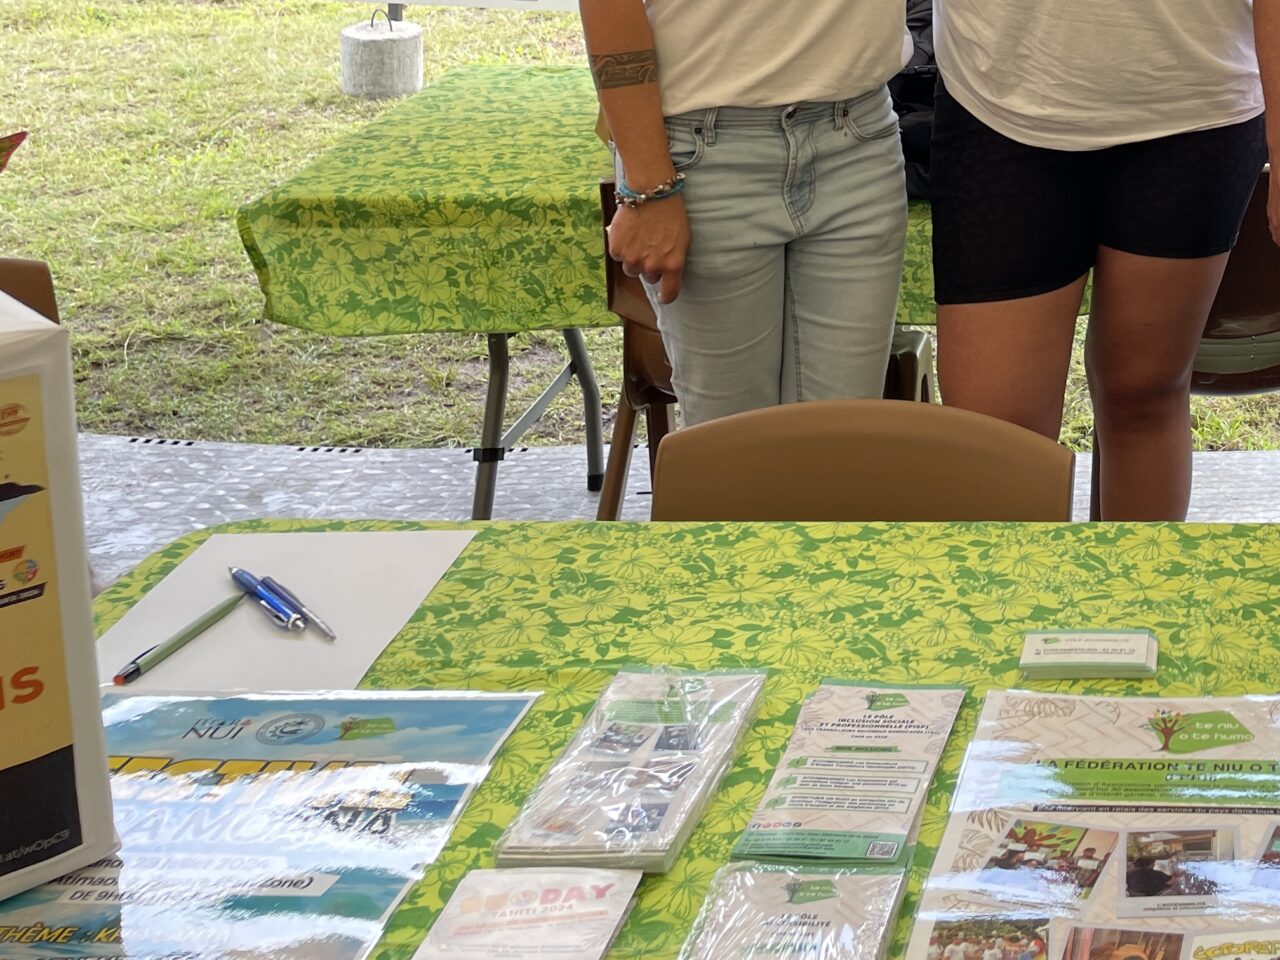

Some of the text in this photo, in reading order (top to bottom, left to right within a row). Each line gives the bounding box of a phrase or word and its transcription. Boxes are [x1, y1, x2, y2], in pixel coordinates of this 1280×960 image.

[1195, 721, 1213, 729] te
[1192, 732, 1210, 740] te
[1064, 758, 1178, 771] FÉDÉRATION
[1213, 762, 1243, 773] NIU
[1249, 762, 1262, 773] O
